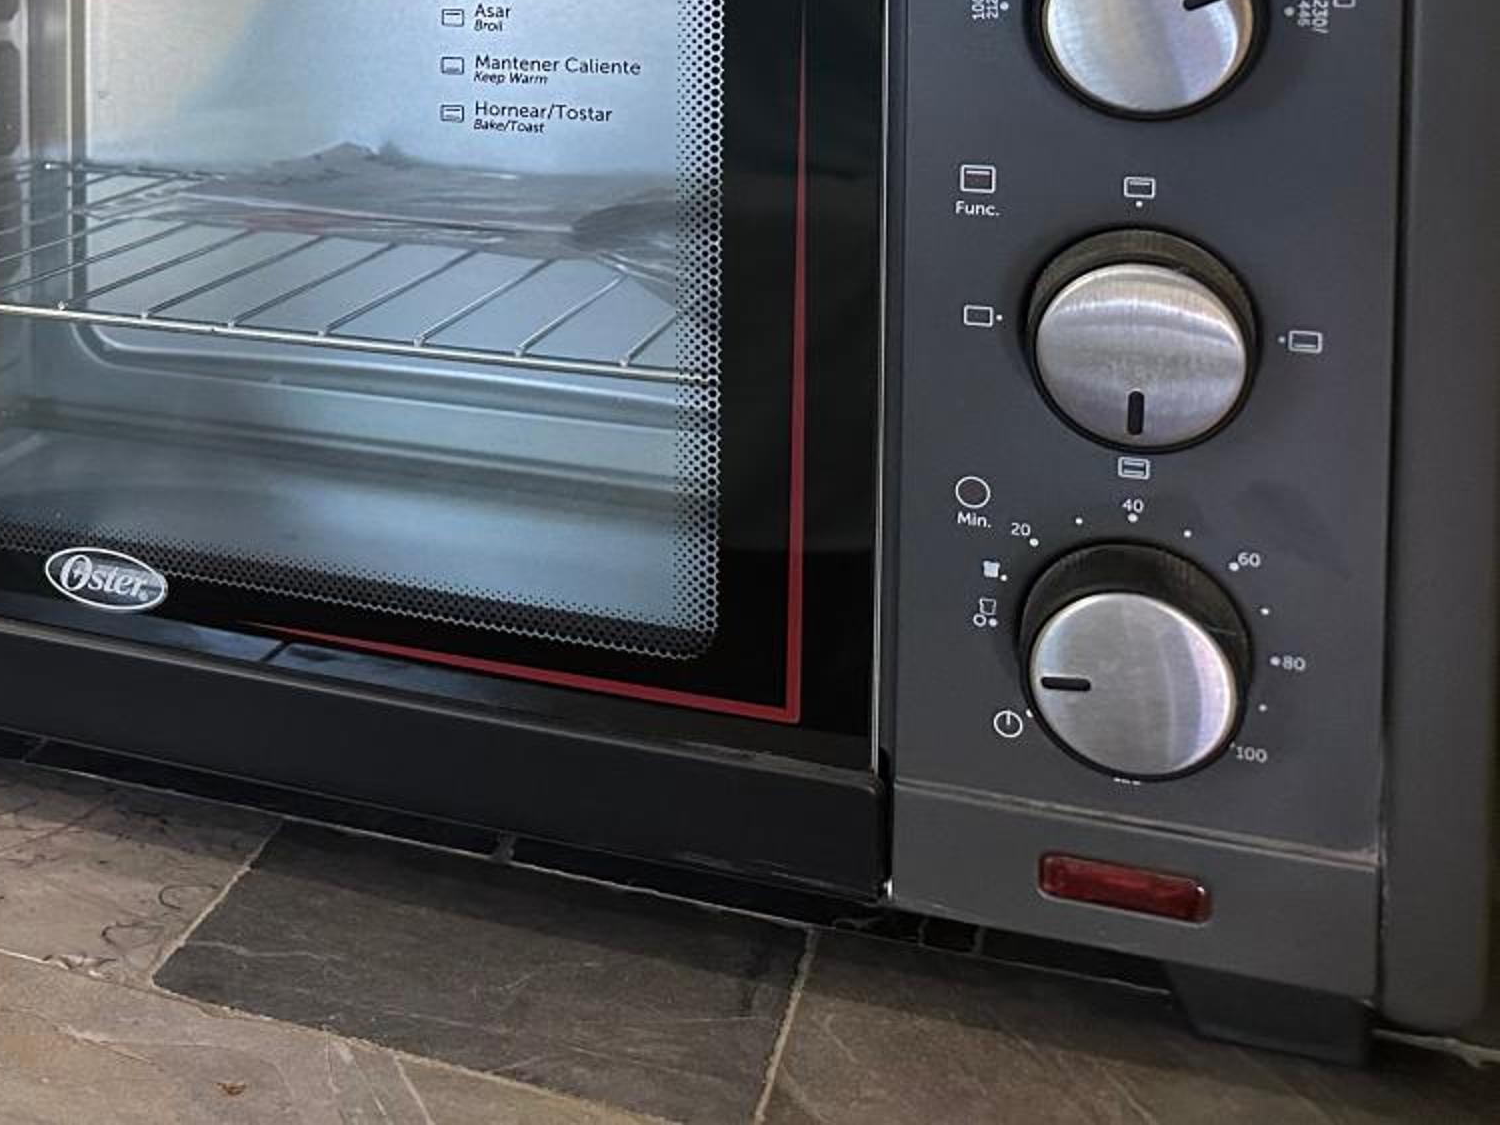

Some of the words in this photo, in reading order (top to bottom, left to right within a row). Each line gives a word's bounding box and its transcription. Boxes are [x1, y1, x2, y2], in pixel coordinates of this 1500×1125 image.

[474, 3, 511, 19] Asar
[474, 18, 503, 32] Broil
[474, 55, 561, 73] Mantener
[565, 56, 642, 76] Caliente
[474, 71, 505, 85] Keep
[509, 73, 548, 86] Warm
[474, 101, 612, 122] Hornear/Tostar
[474, 120, 545, 134] Bake/Toast
[955, 200, 1001, 217] Func.
[1121, 499, 1145, 513] 40
[956, 511, 992, 528] Min.
[1011, 522, 1031, 537] 20
[1238, 552, 1261, 568] 60
[1282, 656, 1306, 671] 80
[1236, 746, 1268, 763] 100
